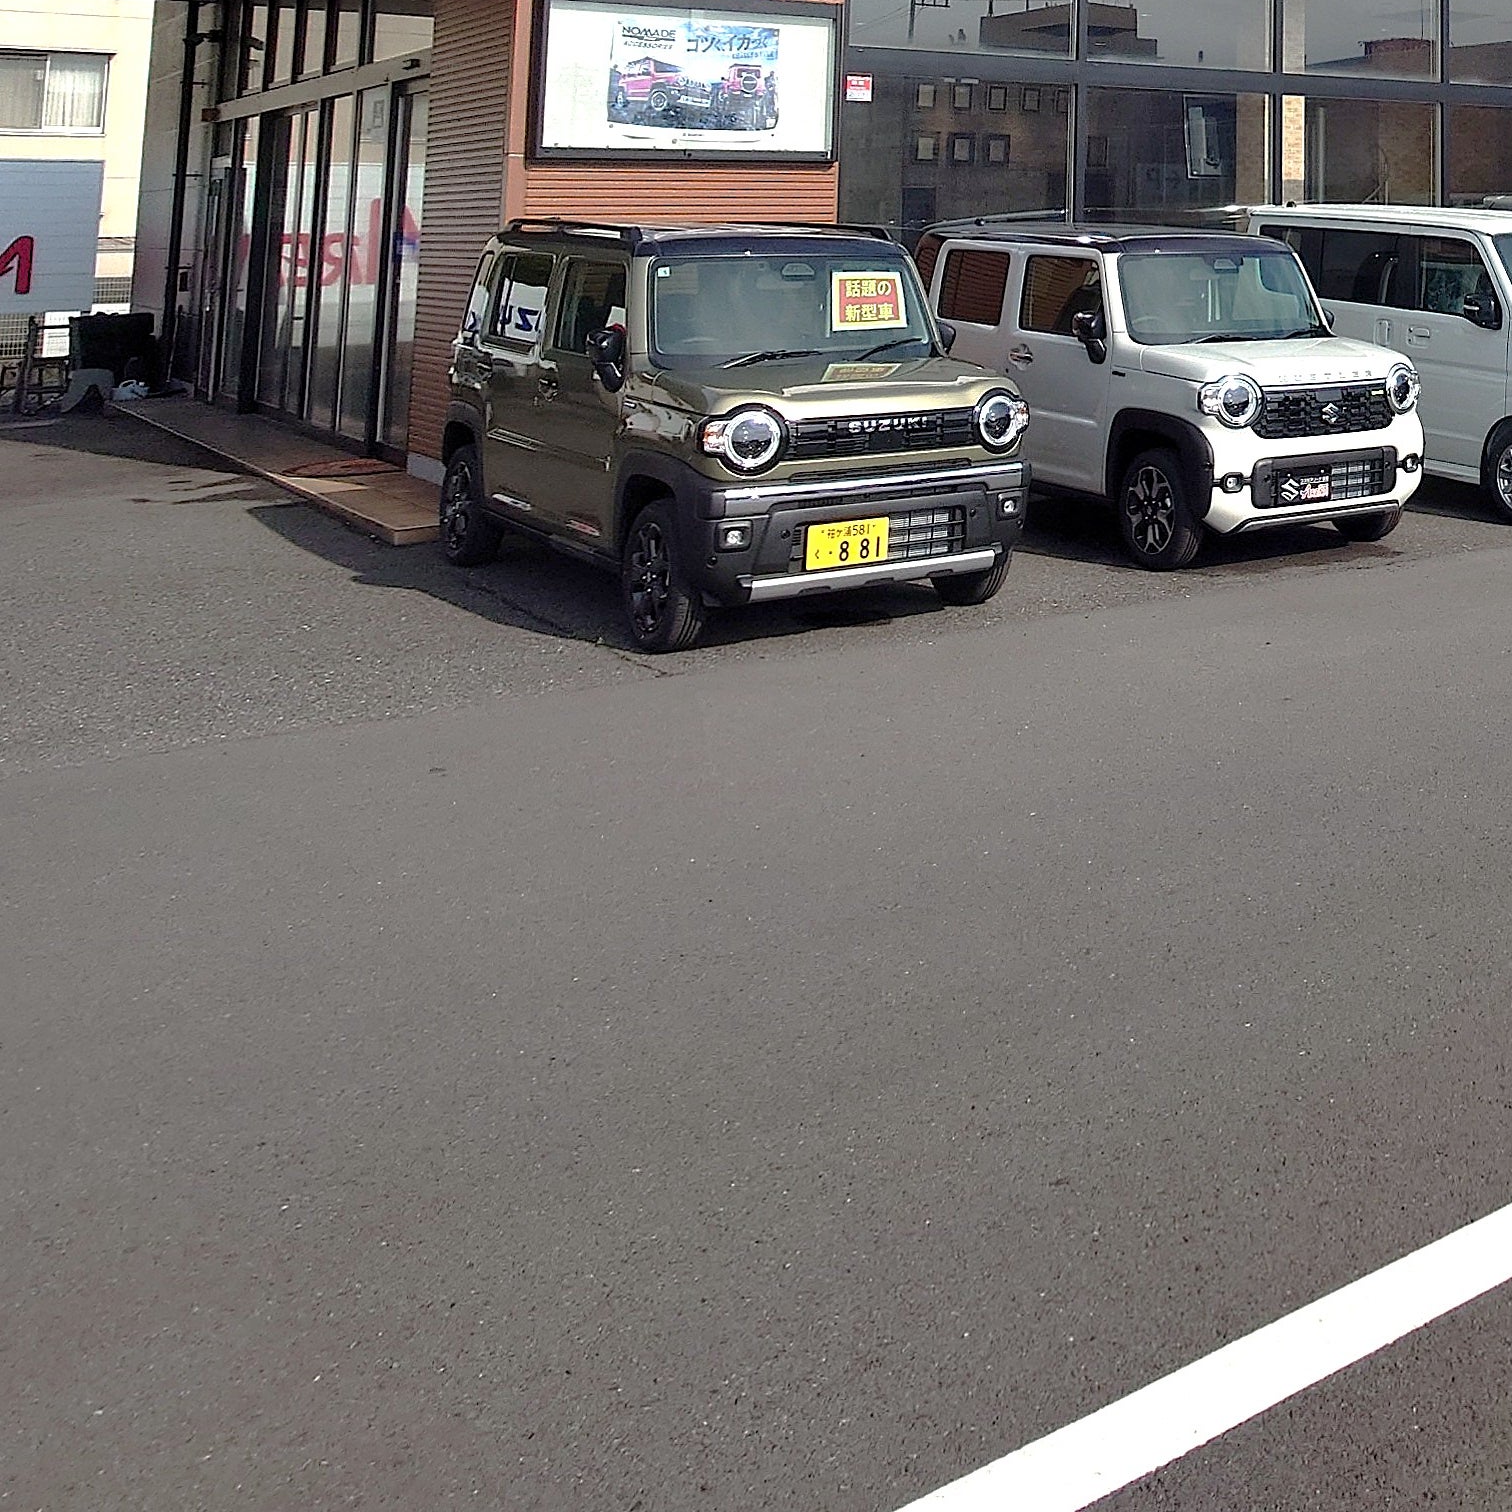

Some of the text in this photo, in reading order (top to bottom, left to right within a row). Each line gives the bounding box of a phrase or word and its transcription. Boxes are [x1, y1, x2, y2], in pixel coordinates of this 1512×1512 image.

[622, 25, 677, 38] NOMADE
[845, 279, 892, 298] 話題の
[845, 303, 895, 322] 新型車
[849, 416, 928, 434] SUZUKI
